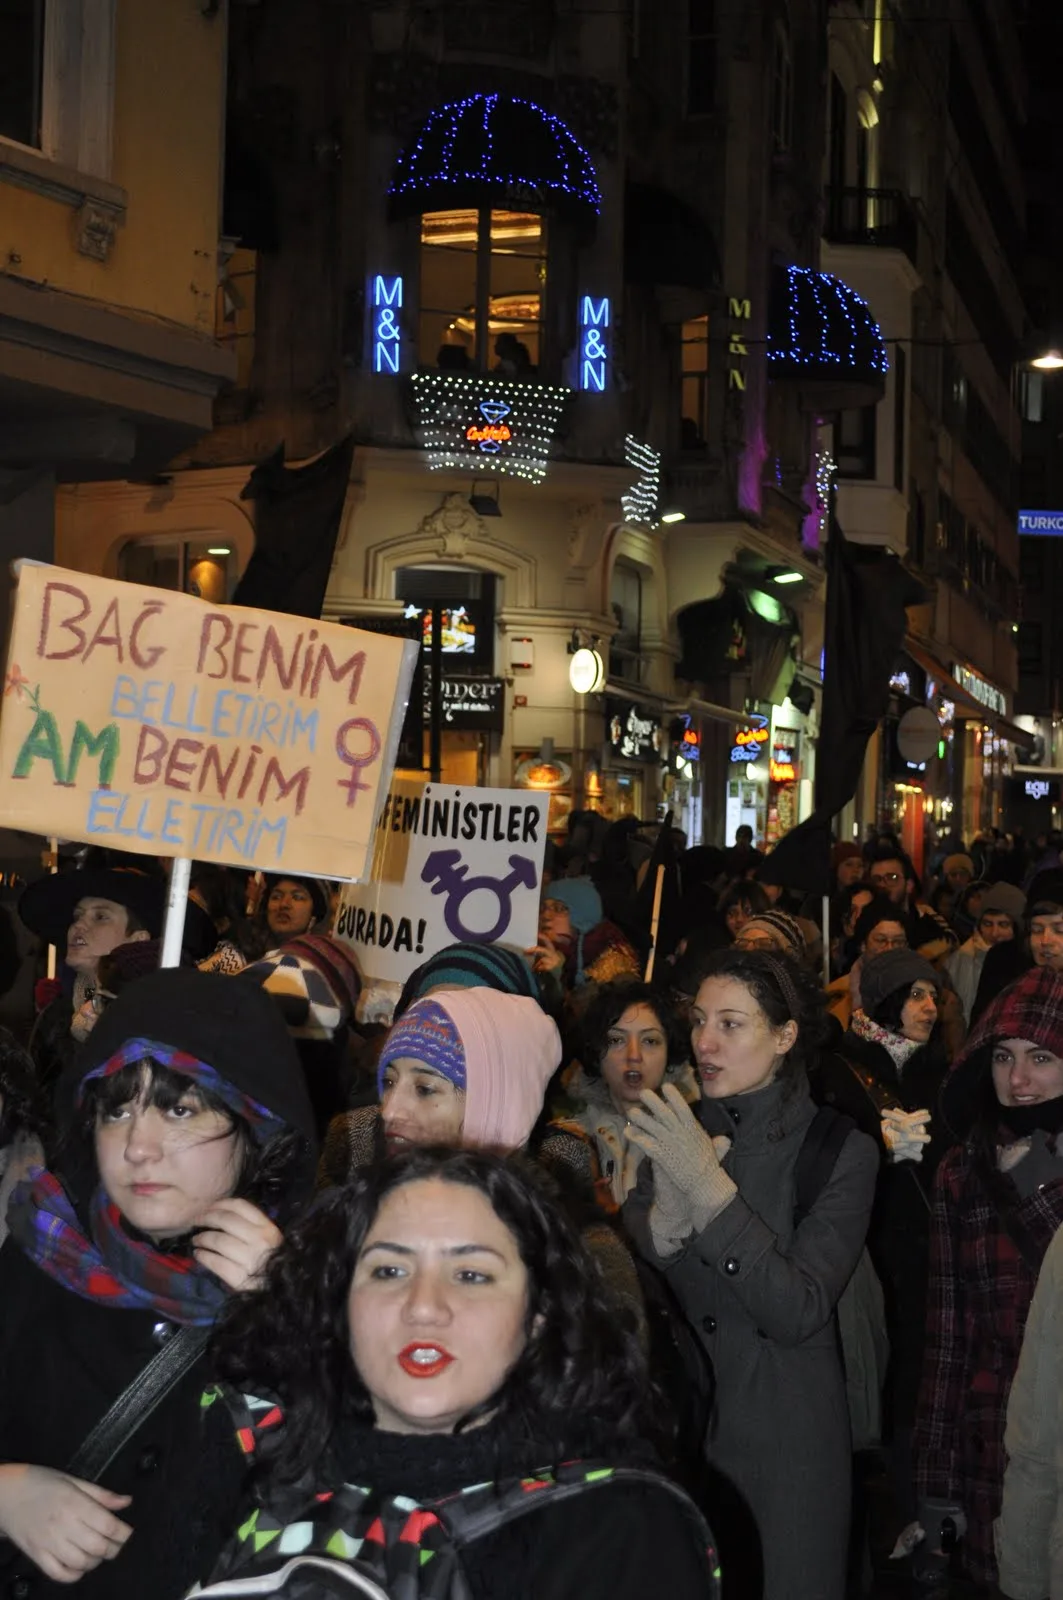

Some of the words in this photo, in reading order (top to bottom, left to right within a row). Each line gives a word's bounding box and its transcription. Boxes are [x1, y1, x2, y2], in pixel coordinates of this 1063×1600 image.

[375, 275, 402, 372] M&N
[583, 296, 609, 391] M&N
[196, 613, 367, 705] BENİM
[11, 708, 120, 789] AM
[134, 724, 311, 816] BENİM
[379, 786, 540, 843] FEMİNİSTLER
[337, 903, 427, 954] BURADA!
